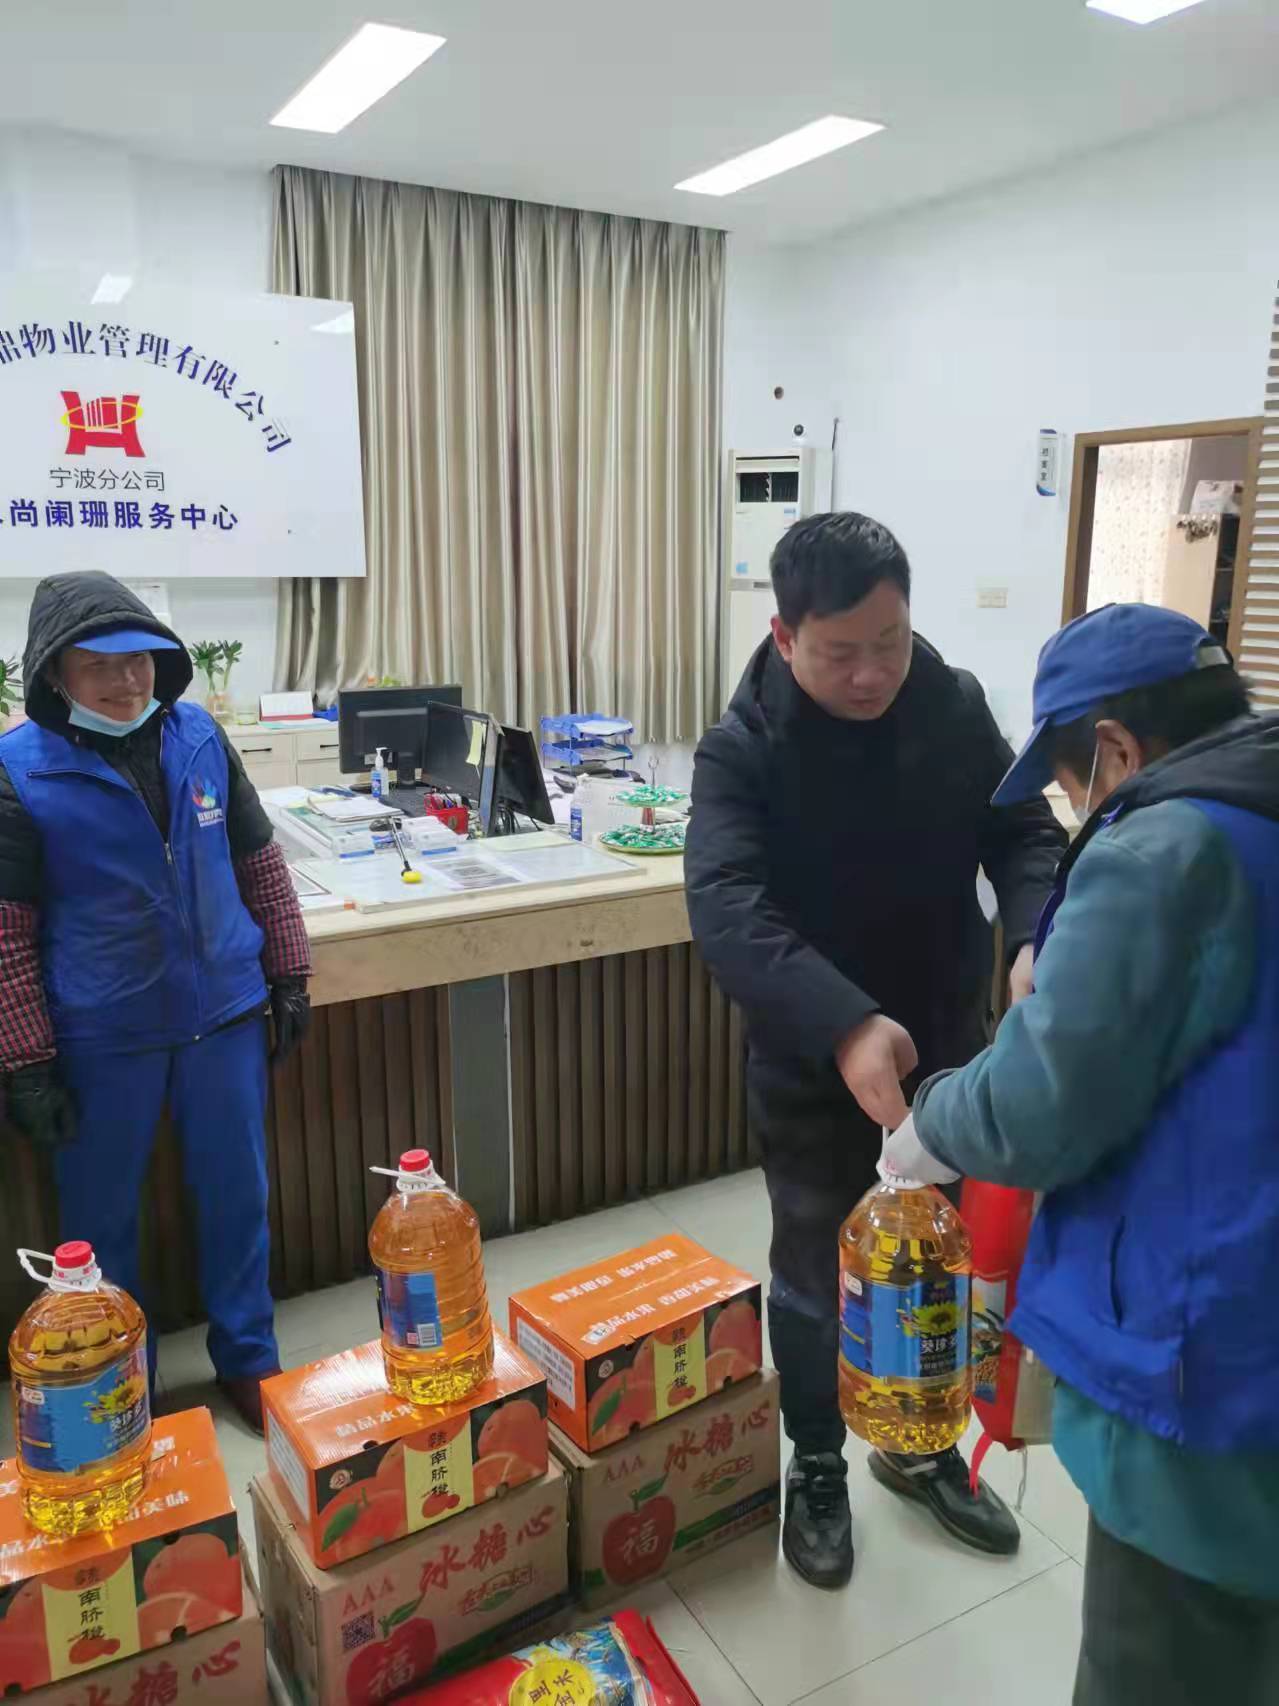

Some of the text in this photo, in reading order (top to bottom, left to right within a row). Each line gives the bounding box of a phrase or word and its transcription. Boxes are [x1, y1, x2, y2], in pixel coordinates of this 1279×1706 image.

[49, 467, 165, 491] 宁波分公司
[0, 498, 238, 530] 尚阑珊服务中心
[663, 1399, 771, 1472] 冰糖心
[418, 1505, 555, 1591] 冰糖心
[622, 1519, 659, 1565] 福
[367, 1648, 417, 1699] 福
